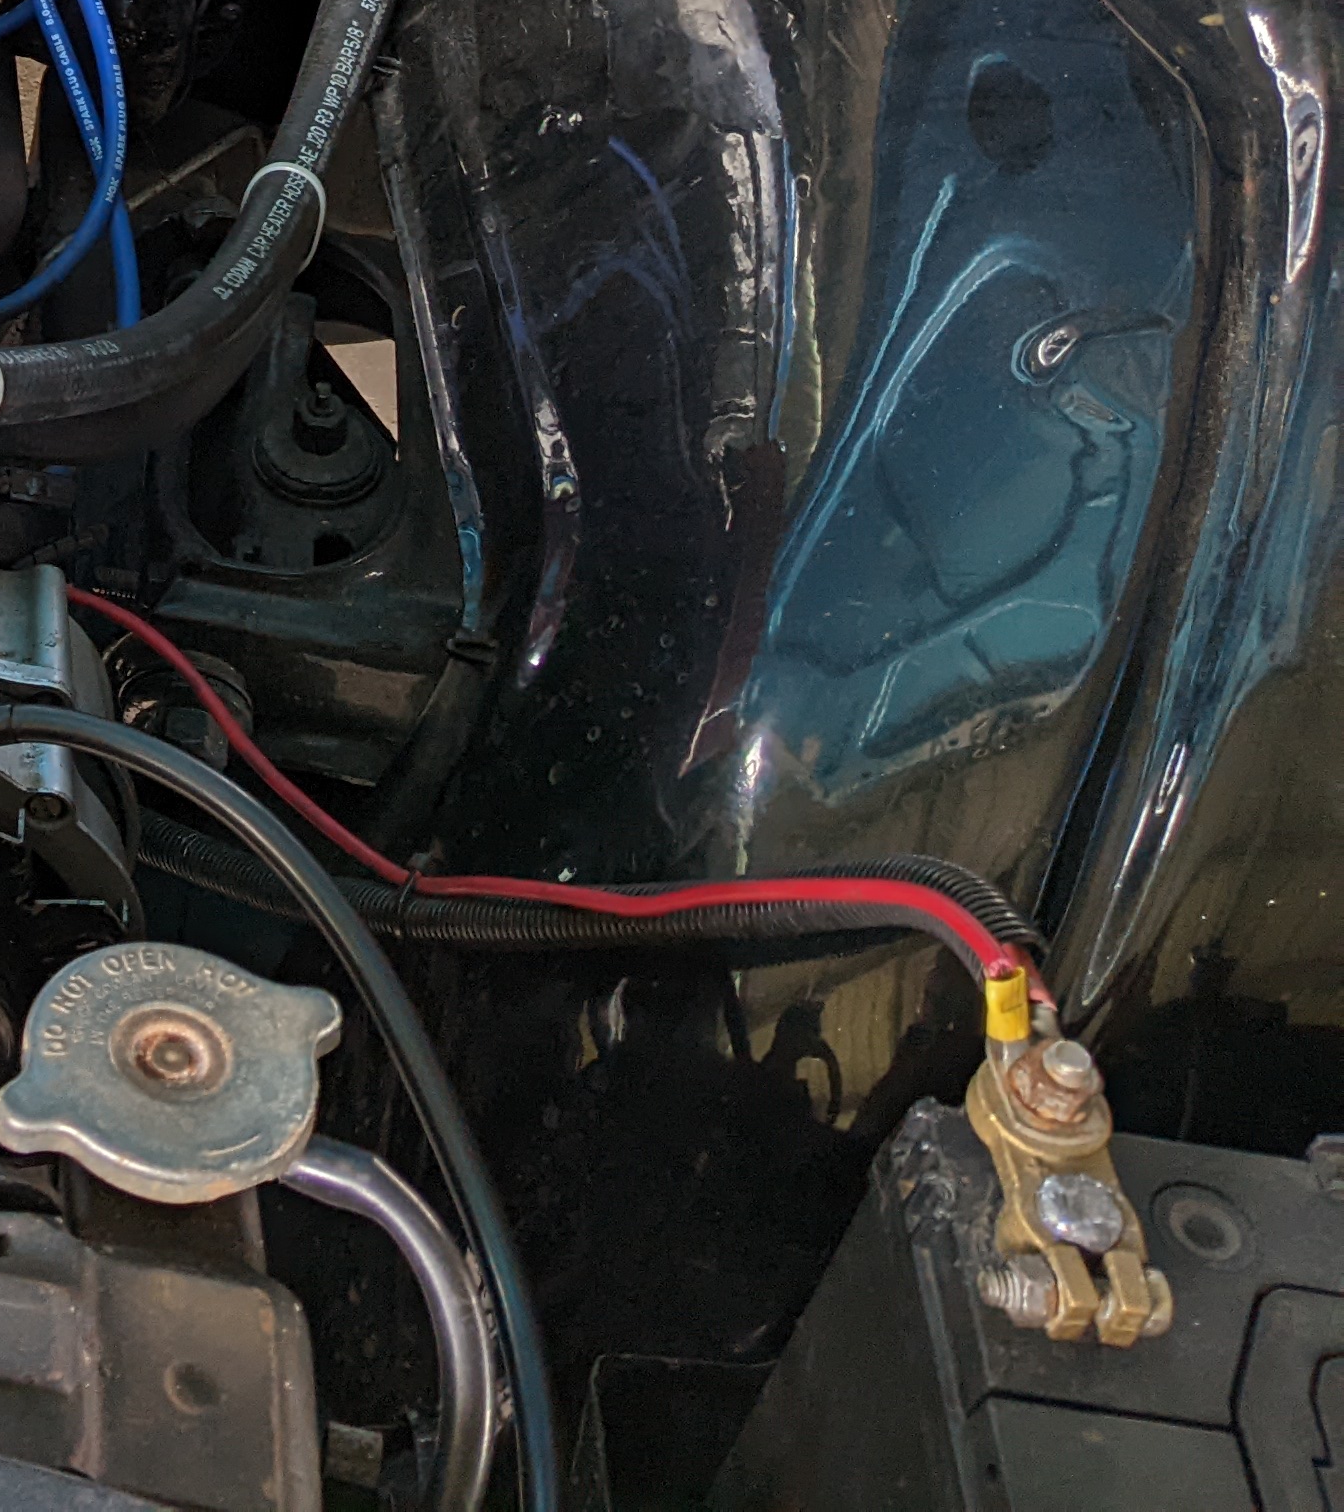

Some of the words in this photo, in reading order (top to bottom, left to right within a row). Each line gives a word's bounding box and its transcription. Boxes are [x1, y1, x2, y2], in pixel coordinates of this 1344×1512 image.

[51, 33, 70, 66] CABLE
[75, 96, 94, 131] SPARK
[222, 257, 258, 288] CODAN
[246, 236, 269, 259] CAR
[259, 198, 295, 241] HEATER
[315, 108, 335, 127] R3
[101, 946, 178, 977] OPEN
[49, 972, 94, 1015] NOT
[42, 1024, 68, 1057] DO
